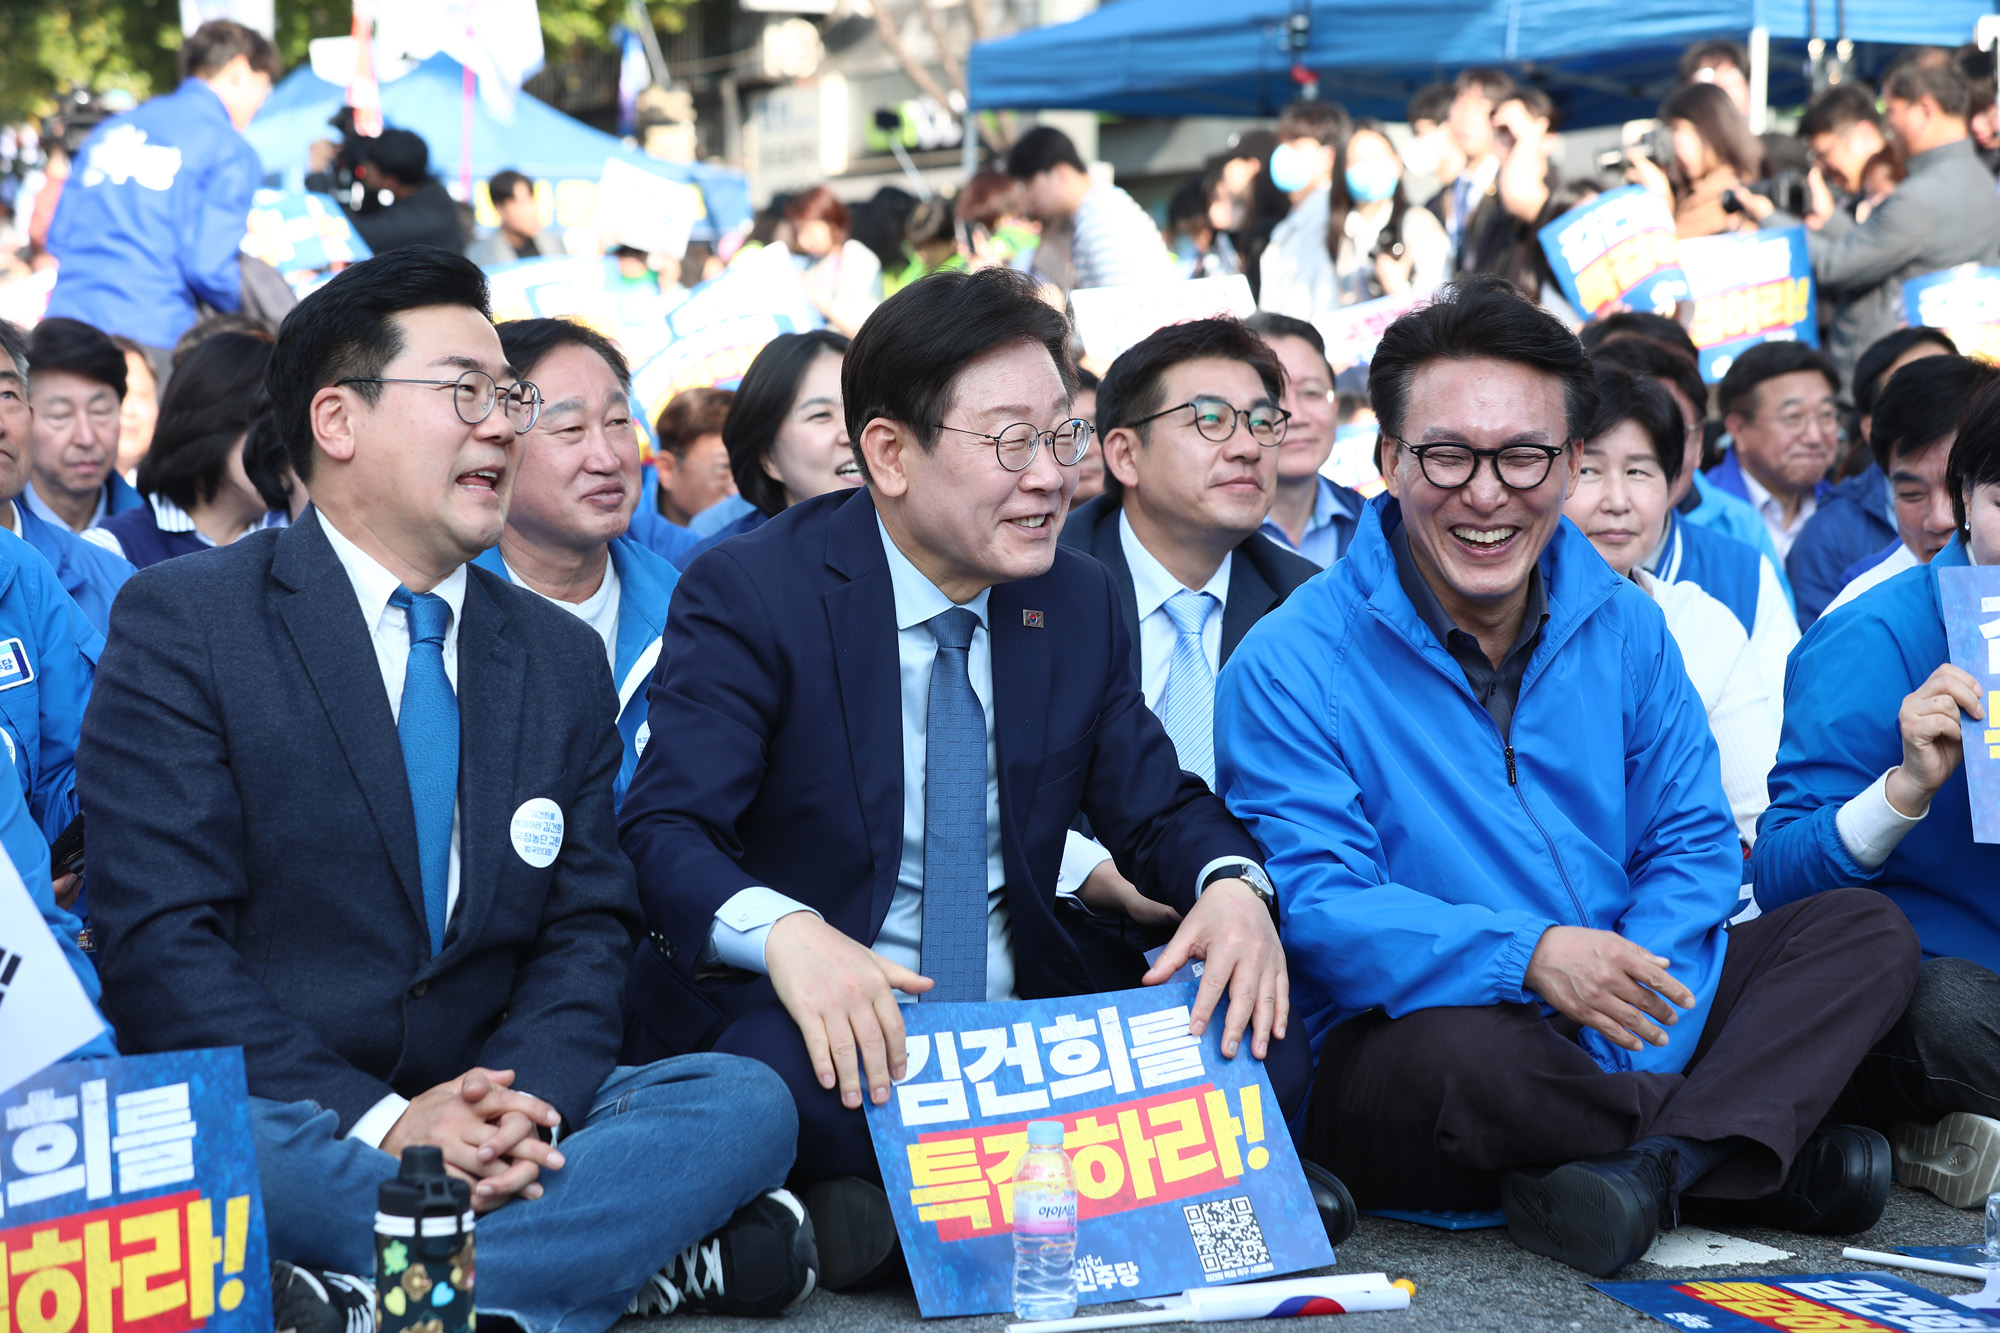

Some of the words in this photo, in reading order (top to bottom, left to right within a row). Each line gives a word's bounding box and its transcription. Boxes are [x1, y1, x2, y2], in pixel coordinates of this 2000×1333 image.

[890, 1005, 1206, 1127] 김건희를
[0, 1078, 197, 1207] 희를
[0, 1194, 250, 1333] 하라!
[1075, 1261, 1140, 1293] 민주당
